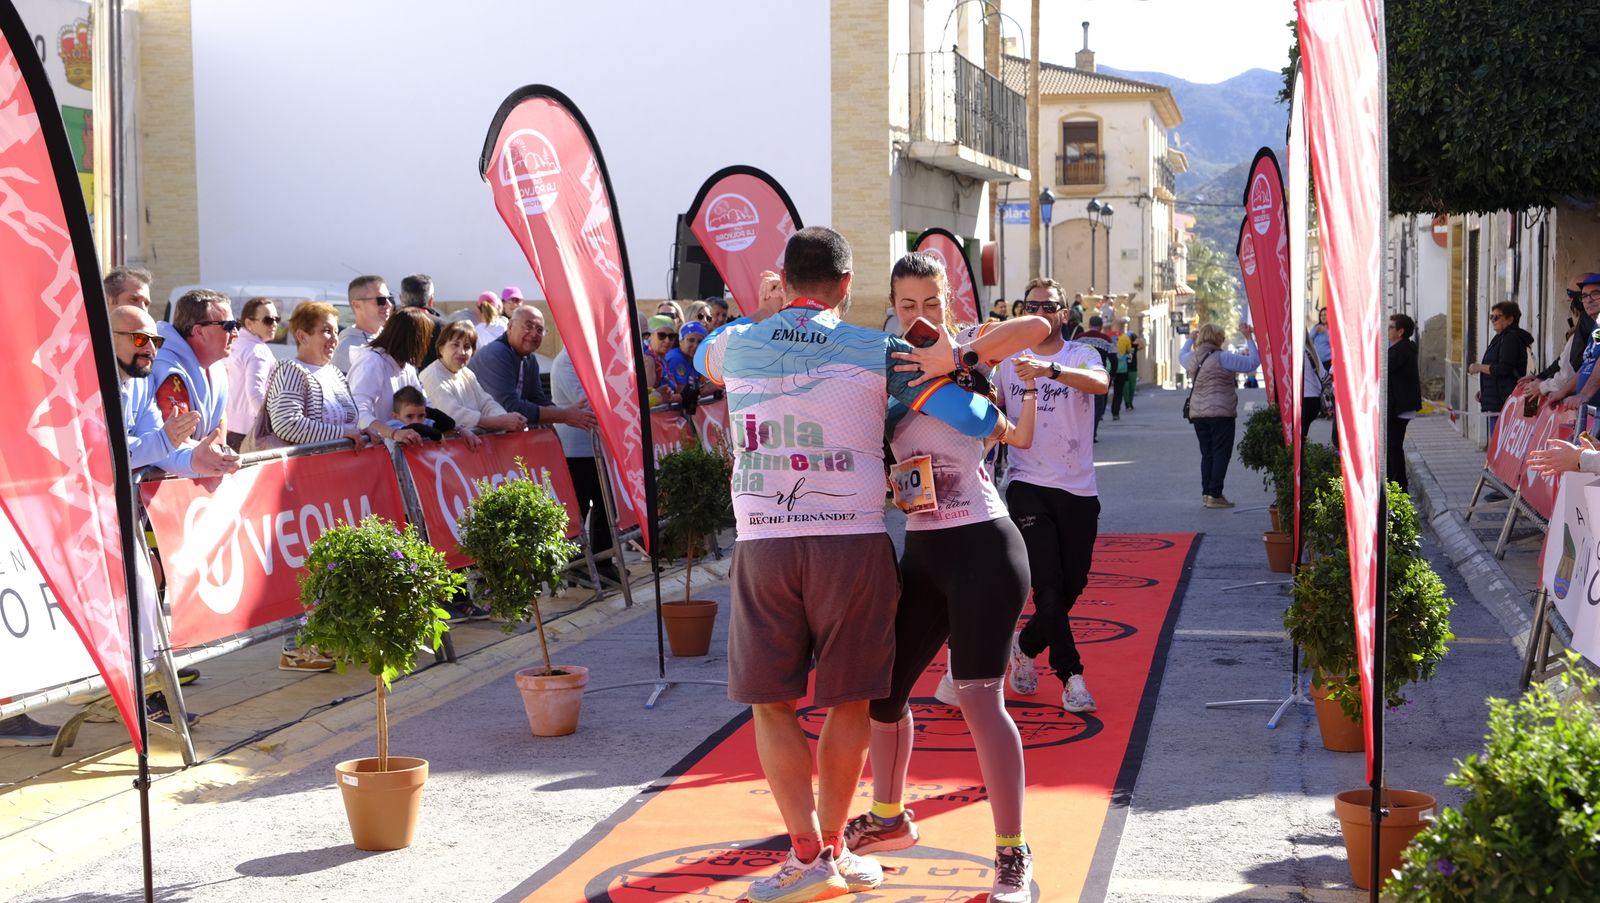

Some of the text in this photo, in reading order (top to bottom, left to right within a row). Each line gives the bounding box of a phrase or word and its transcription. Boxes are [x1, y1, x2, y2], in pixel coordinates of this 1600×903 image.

[771, 328, 828, 344] EMILIO
[1037, 404, 1055, 413] eaker
[731, 413, 825, 451] ijola
[733, 469, 764, 492] ela
[750, 511, 857, 525] RECHE FERNÁNDEZ
[936, 509, 969, 521] Team
[708, 850, 788, 859] ntoria
